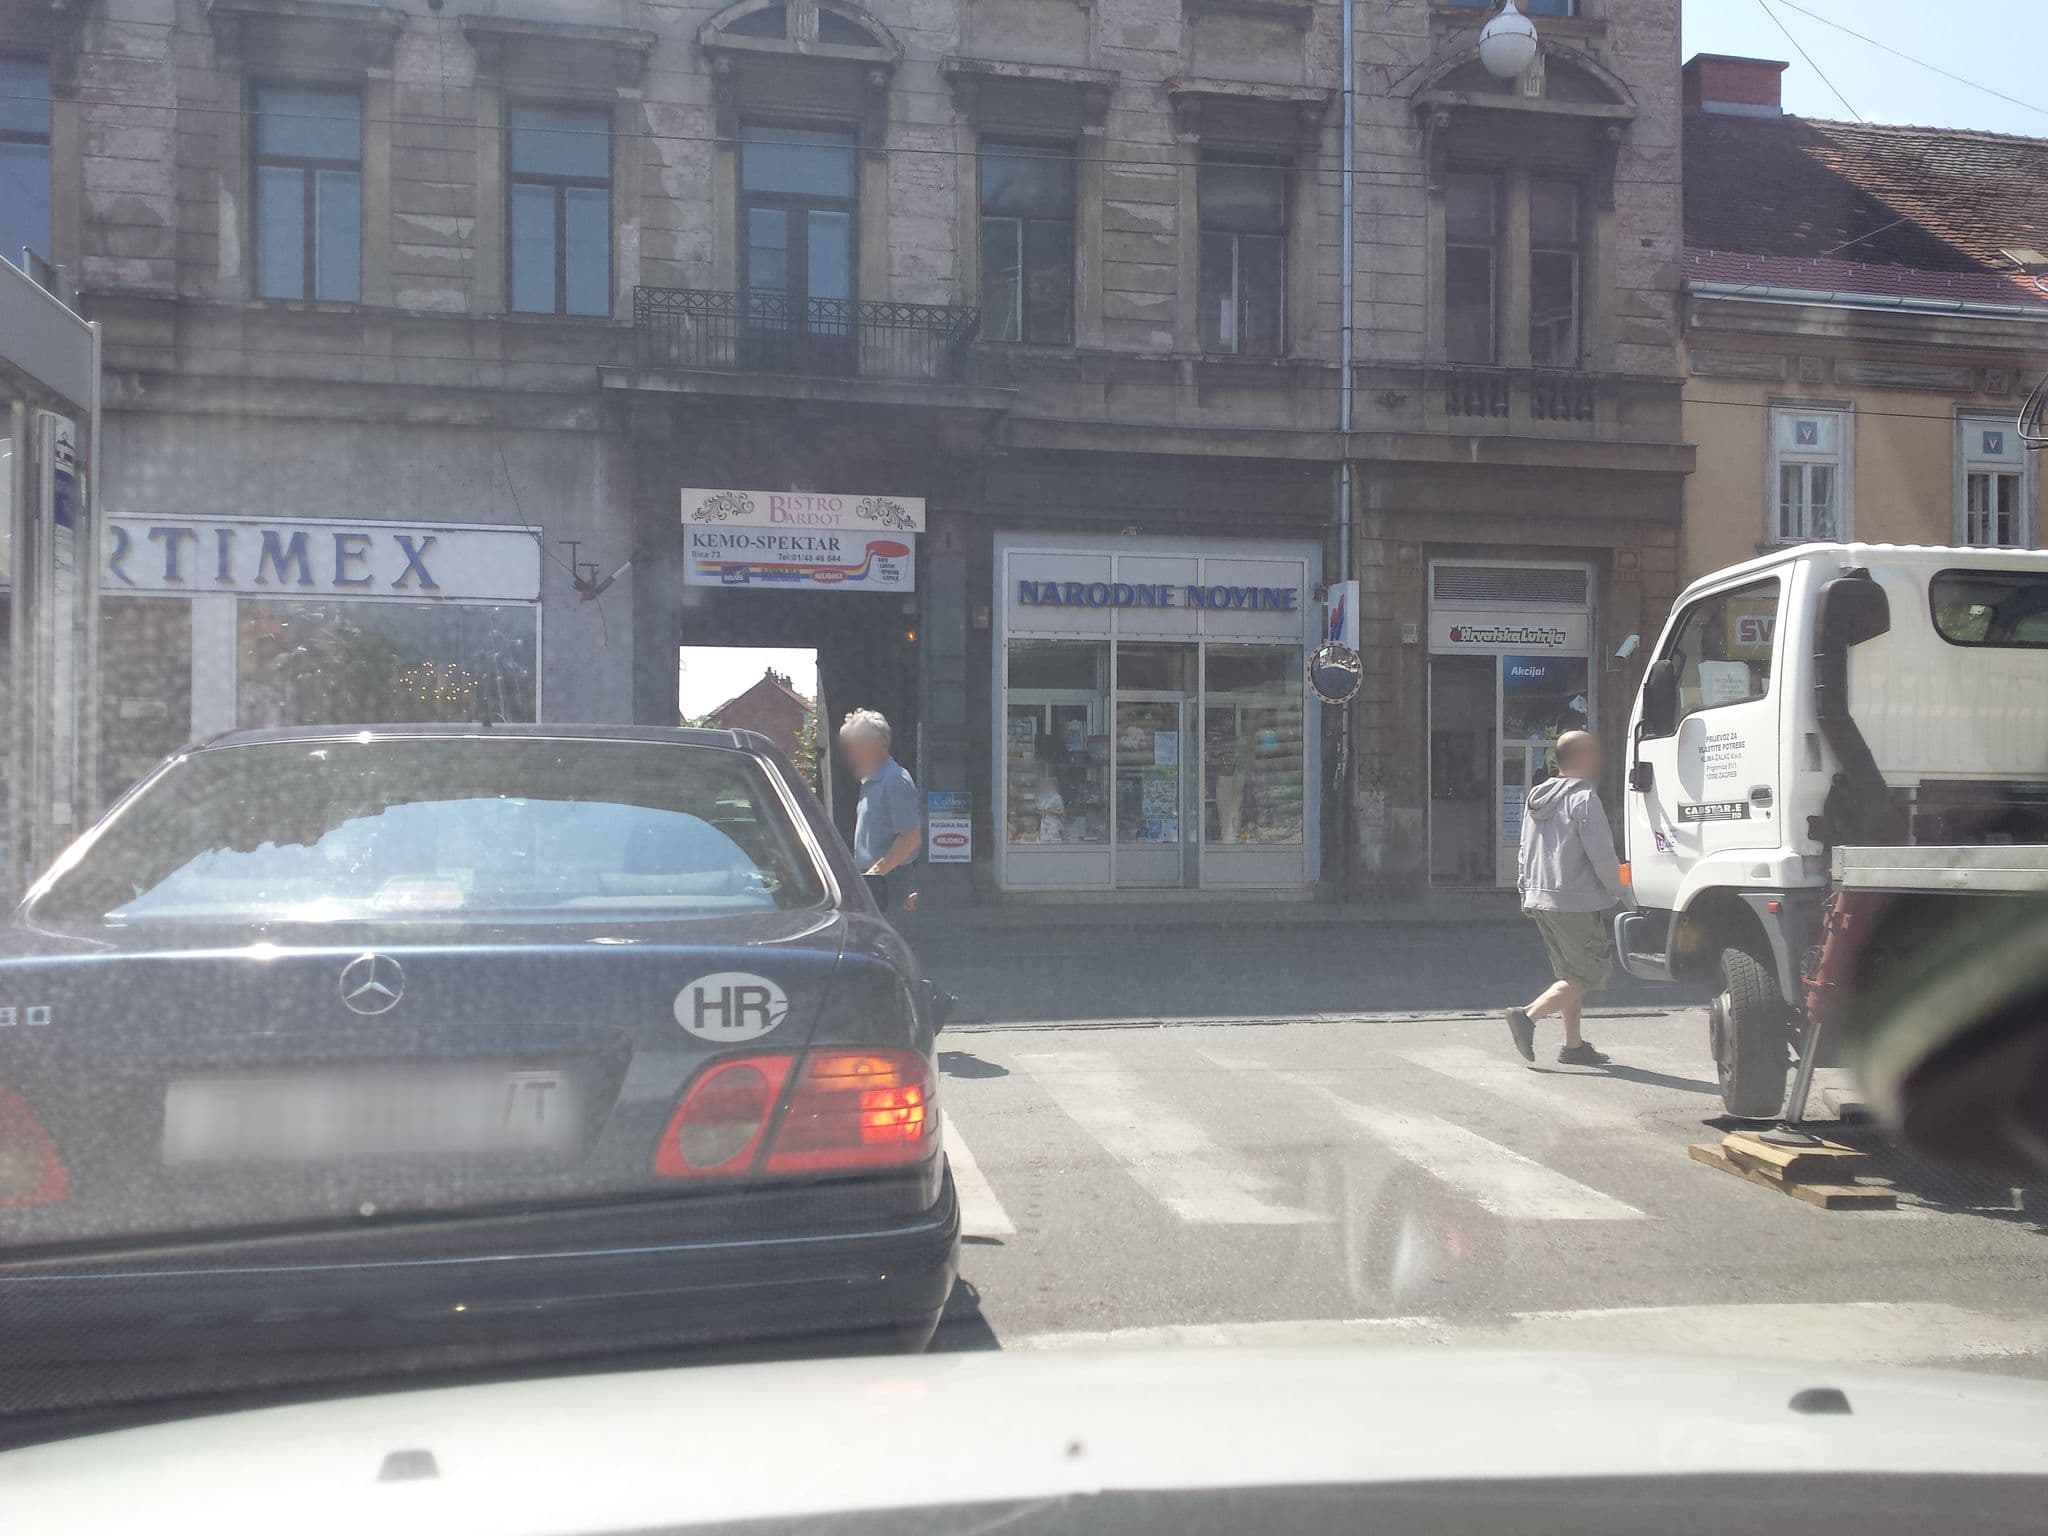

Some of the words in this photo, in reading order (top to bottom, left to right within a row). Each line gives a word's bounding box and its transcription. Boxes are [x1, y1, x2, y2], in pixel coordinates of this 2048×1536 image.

[770, 495, 842, 517] BISTRO
[692, 533, 841, 551] KEMO-SPEKTAR
[1018, 580, 1175, 608] NARODNE
[1187, 584, 1298, 611] NOVINE
[1511, 666, 1545, 677] Akcija!
[1705, 733, 1730, 743] PRIJEVOZ
[1730, 731, 1738, 740] ZA
[1698, 743, 1722, 754] VLASTITE
[1722, 740, 1746, 751] POTREBE
[694, 985, 773, 1029] HR
